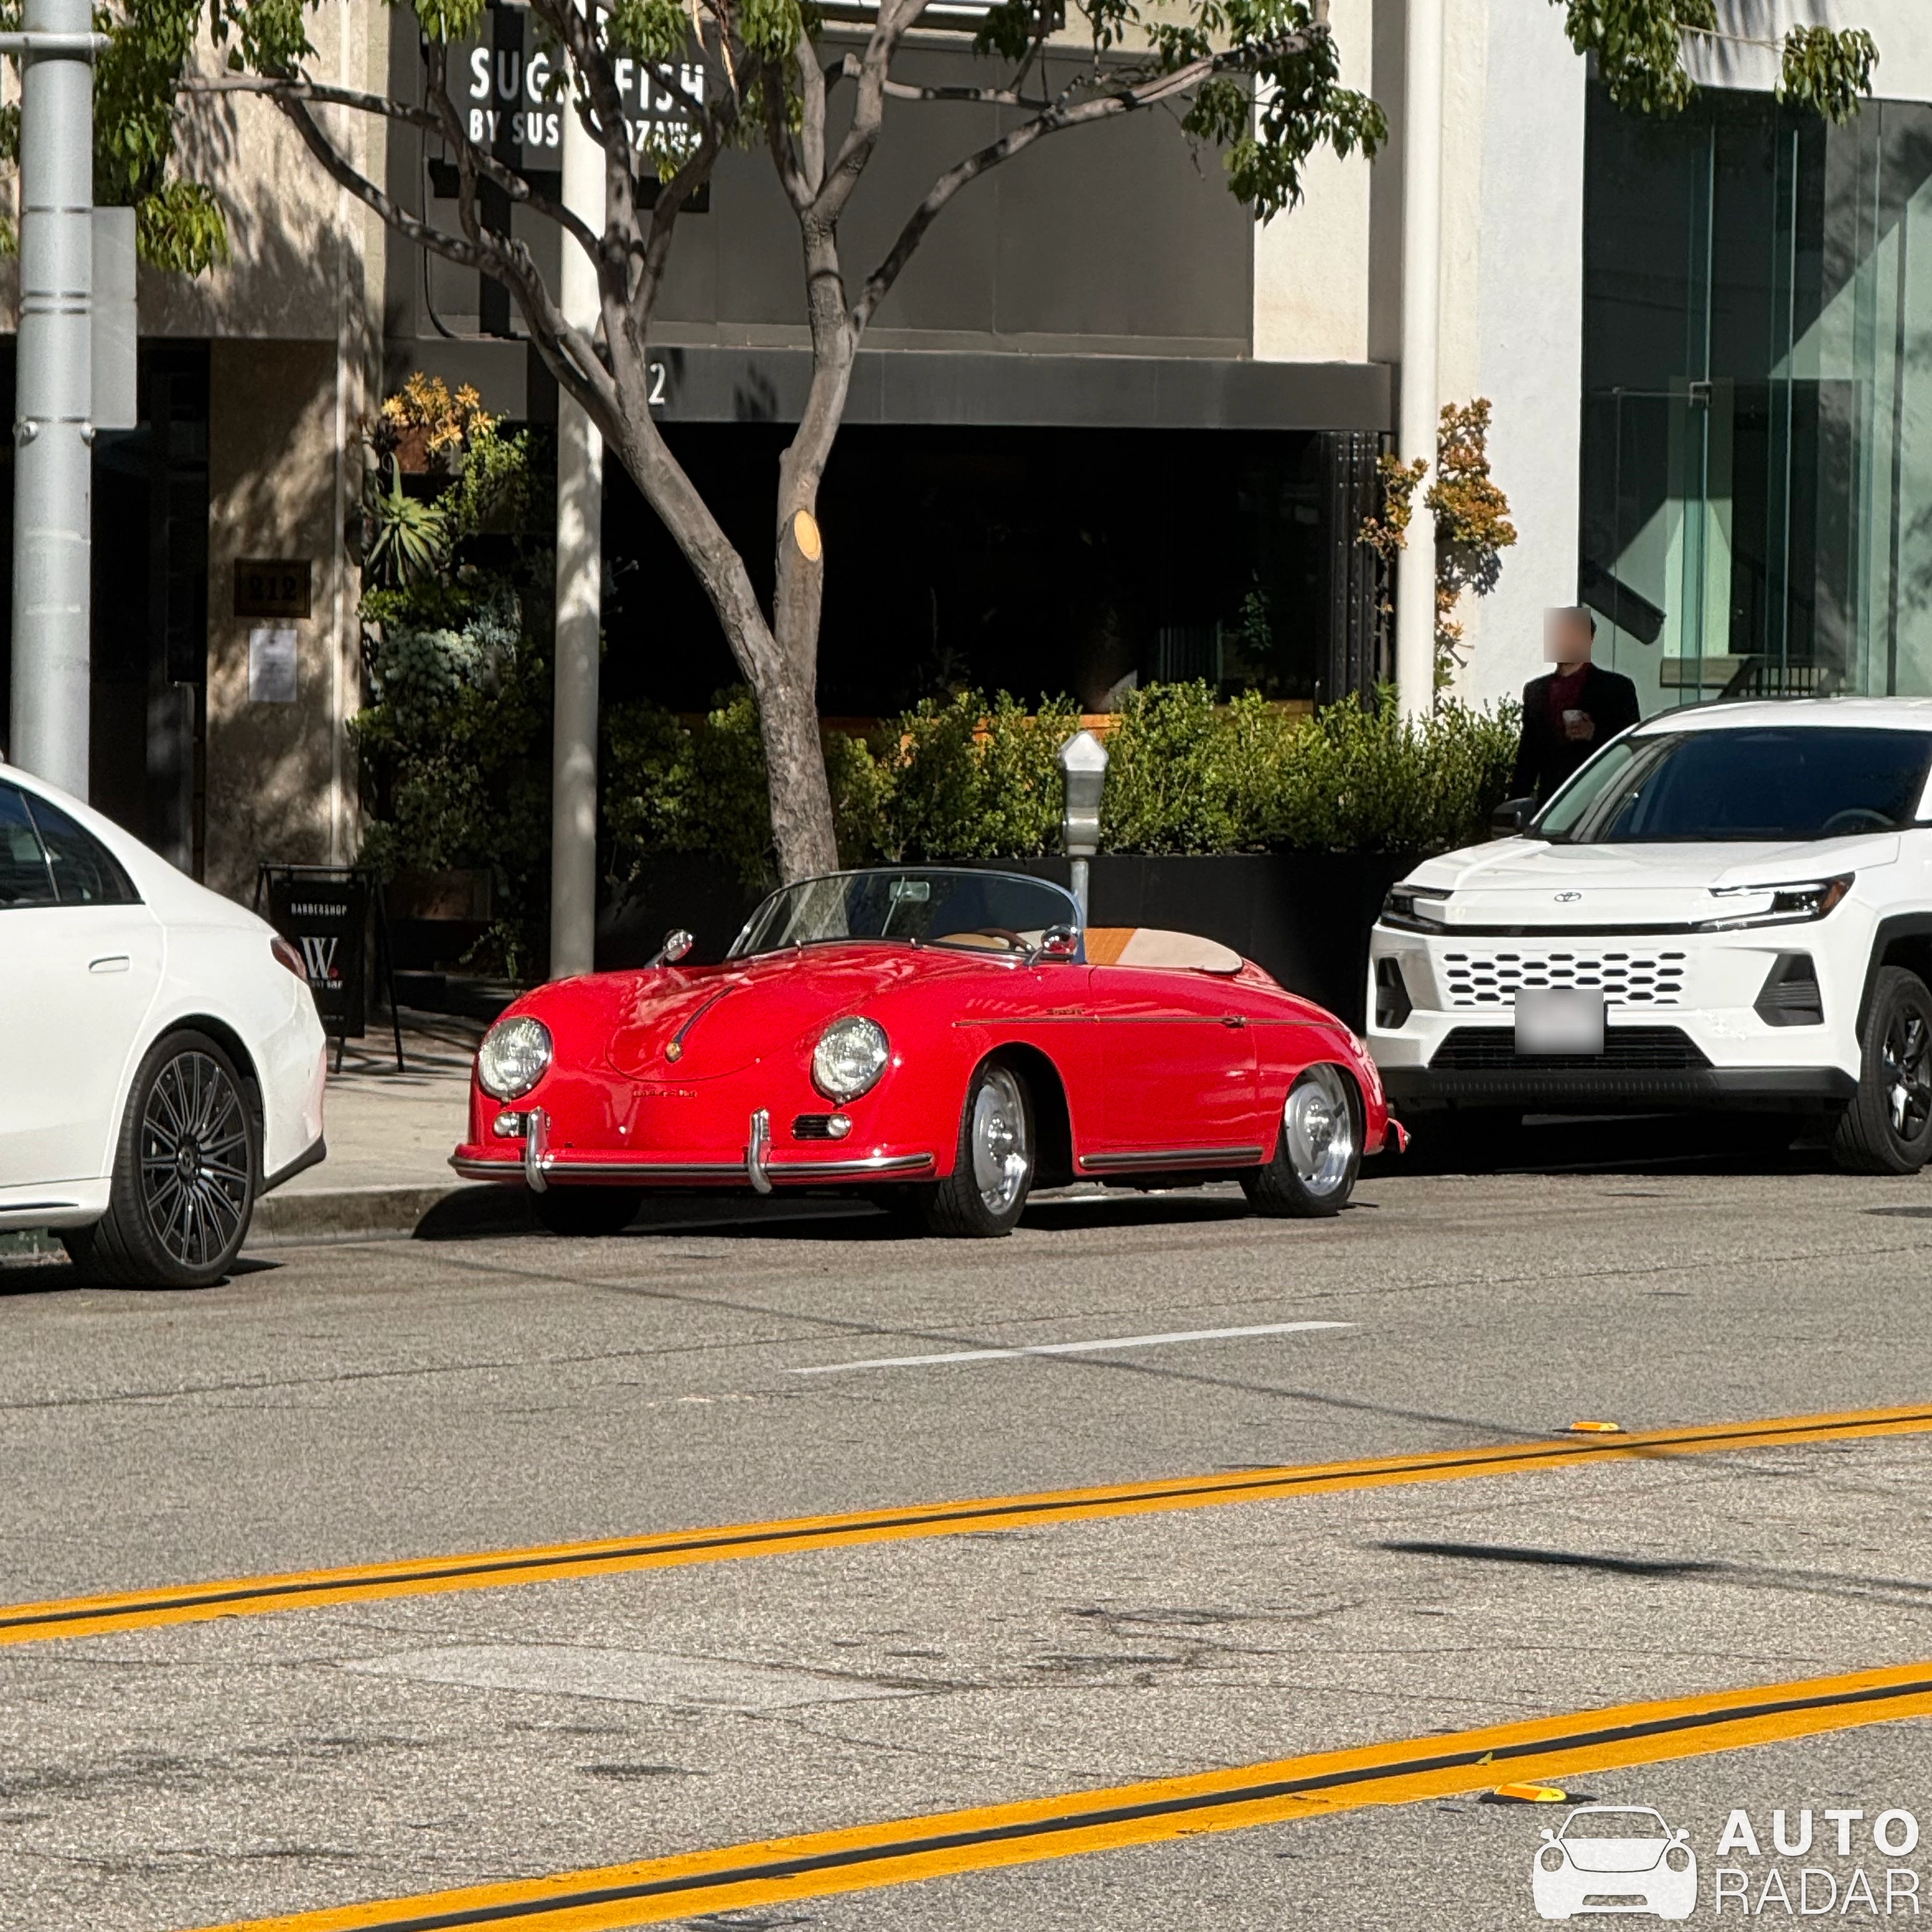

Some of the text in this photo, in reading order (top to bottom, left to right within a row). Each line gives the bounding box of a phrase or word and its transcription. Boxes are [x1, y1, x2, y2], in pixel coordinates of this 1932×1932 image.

[470, 47, 705, 114] SUGFISH
[470, 109, 502, 143] BY
[249, 574, 296, 600] 212
[291, 903, 348, 916] BARBERSHOP
